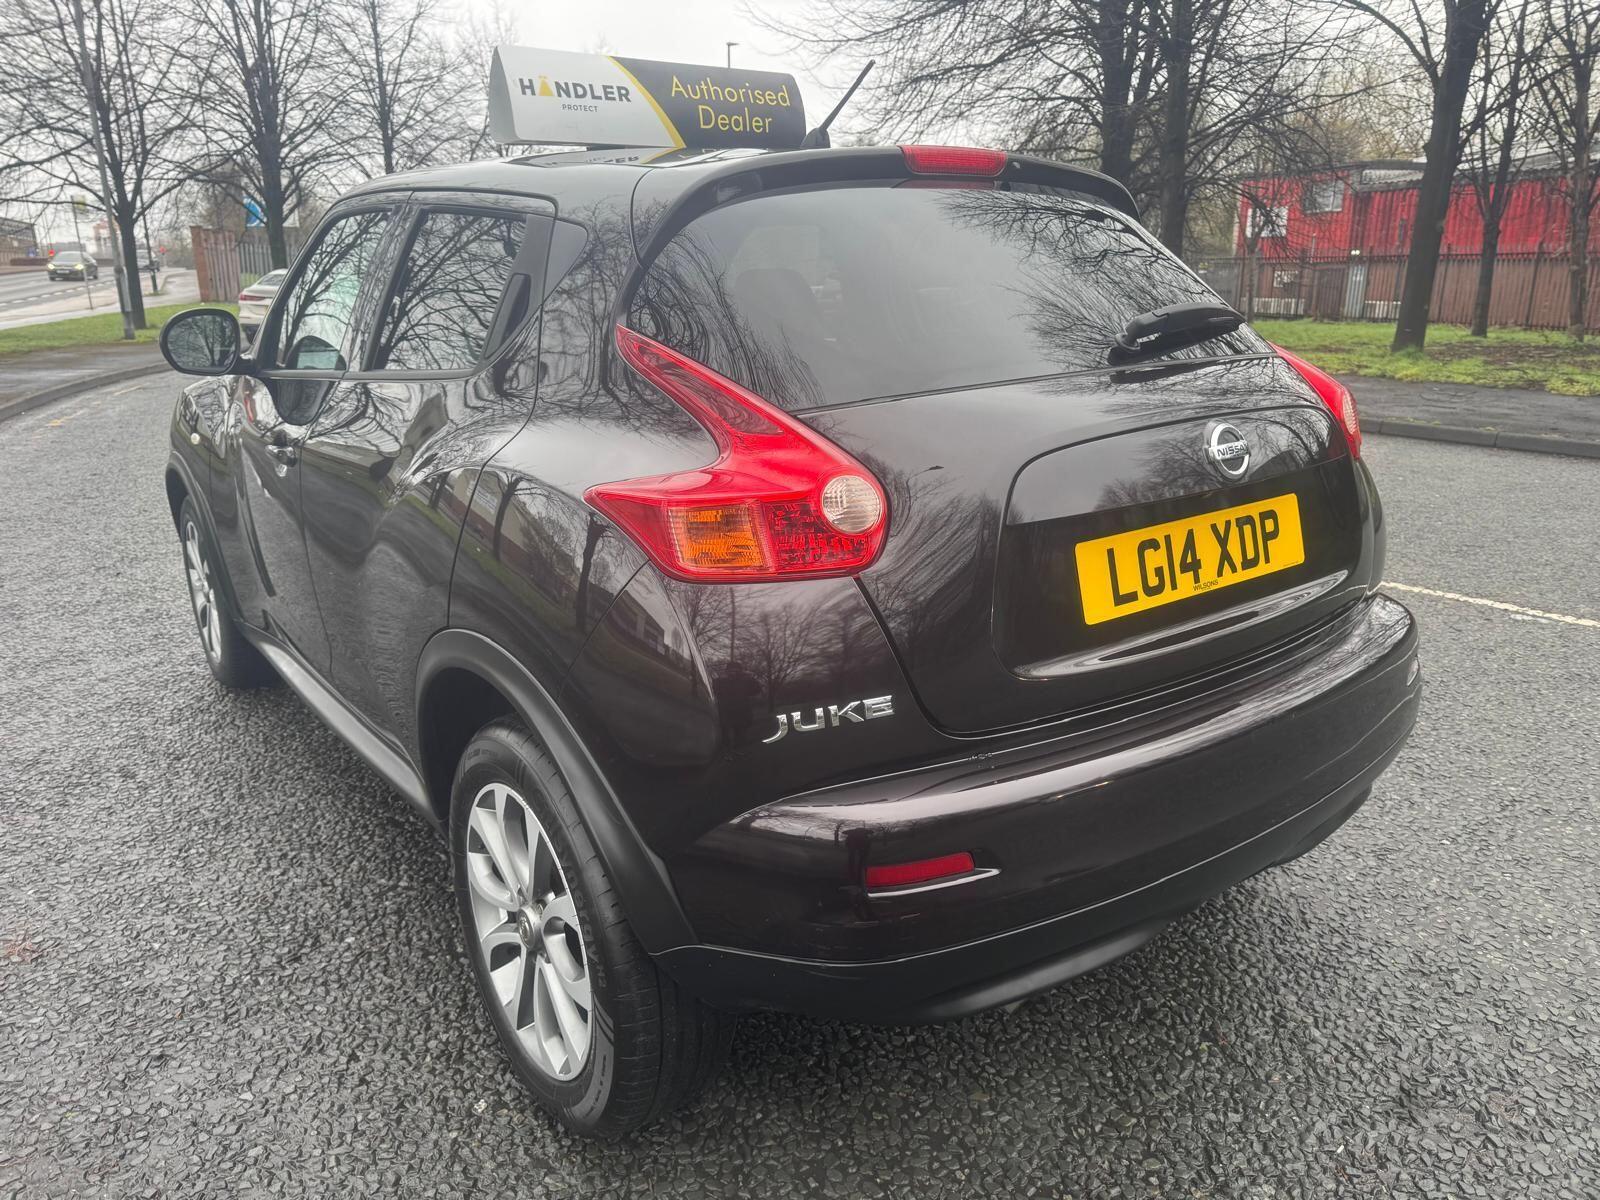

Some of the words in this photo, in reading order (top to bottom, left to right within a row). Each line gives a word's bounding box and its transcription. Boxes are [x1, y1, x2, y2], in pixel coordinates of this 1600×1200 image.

[671, 75, 791, 107] Authorised
[562, 103, 598, 112] PROTECT
[699, 104, 773, 134] Dealer
[1106, 528, 1202, 607] LG14
[1210, 509, 1280, 578] XDP
[1192, 579, 1219, 591] WILSONS
[761, 695, 896, 744] JUKE
